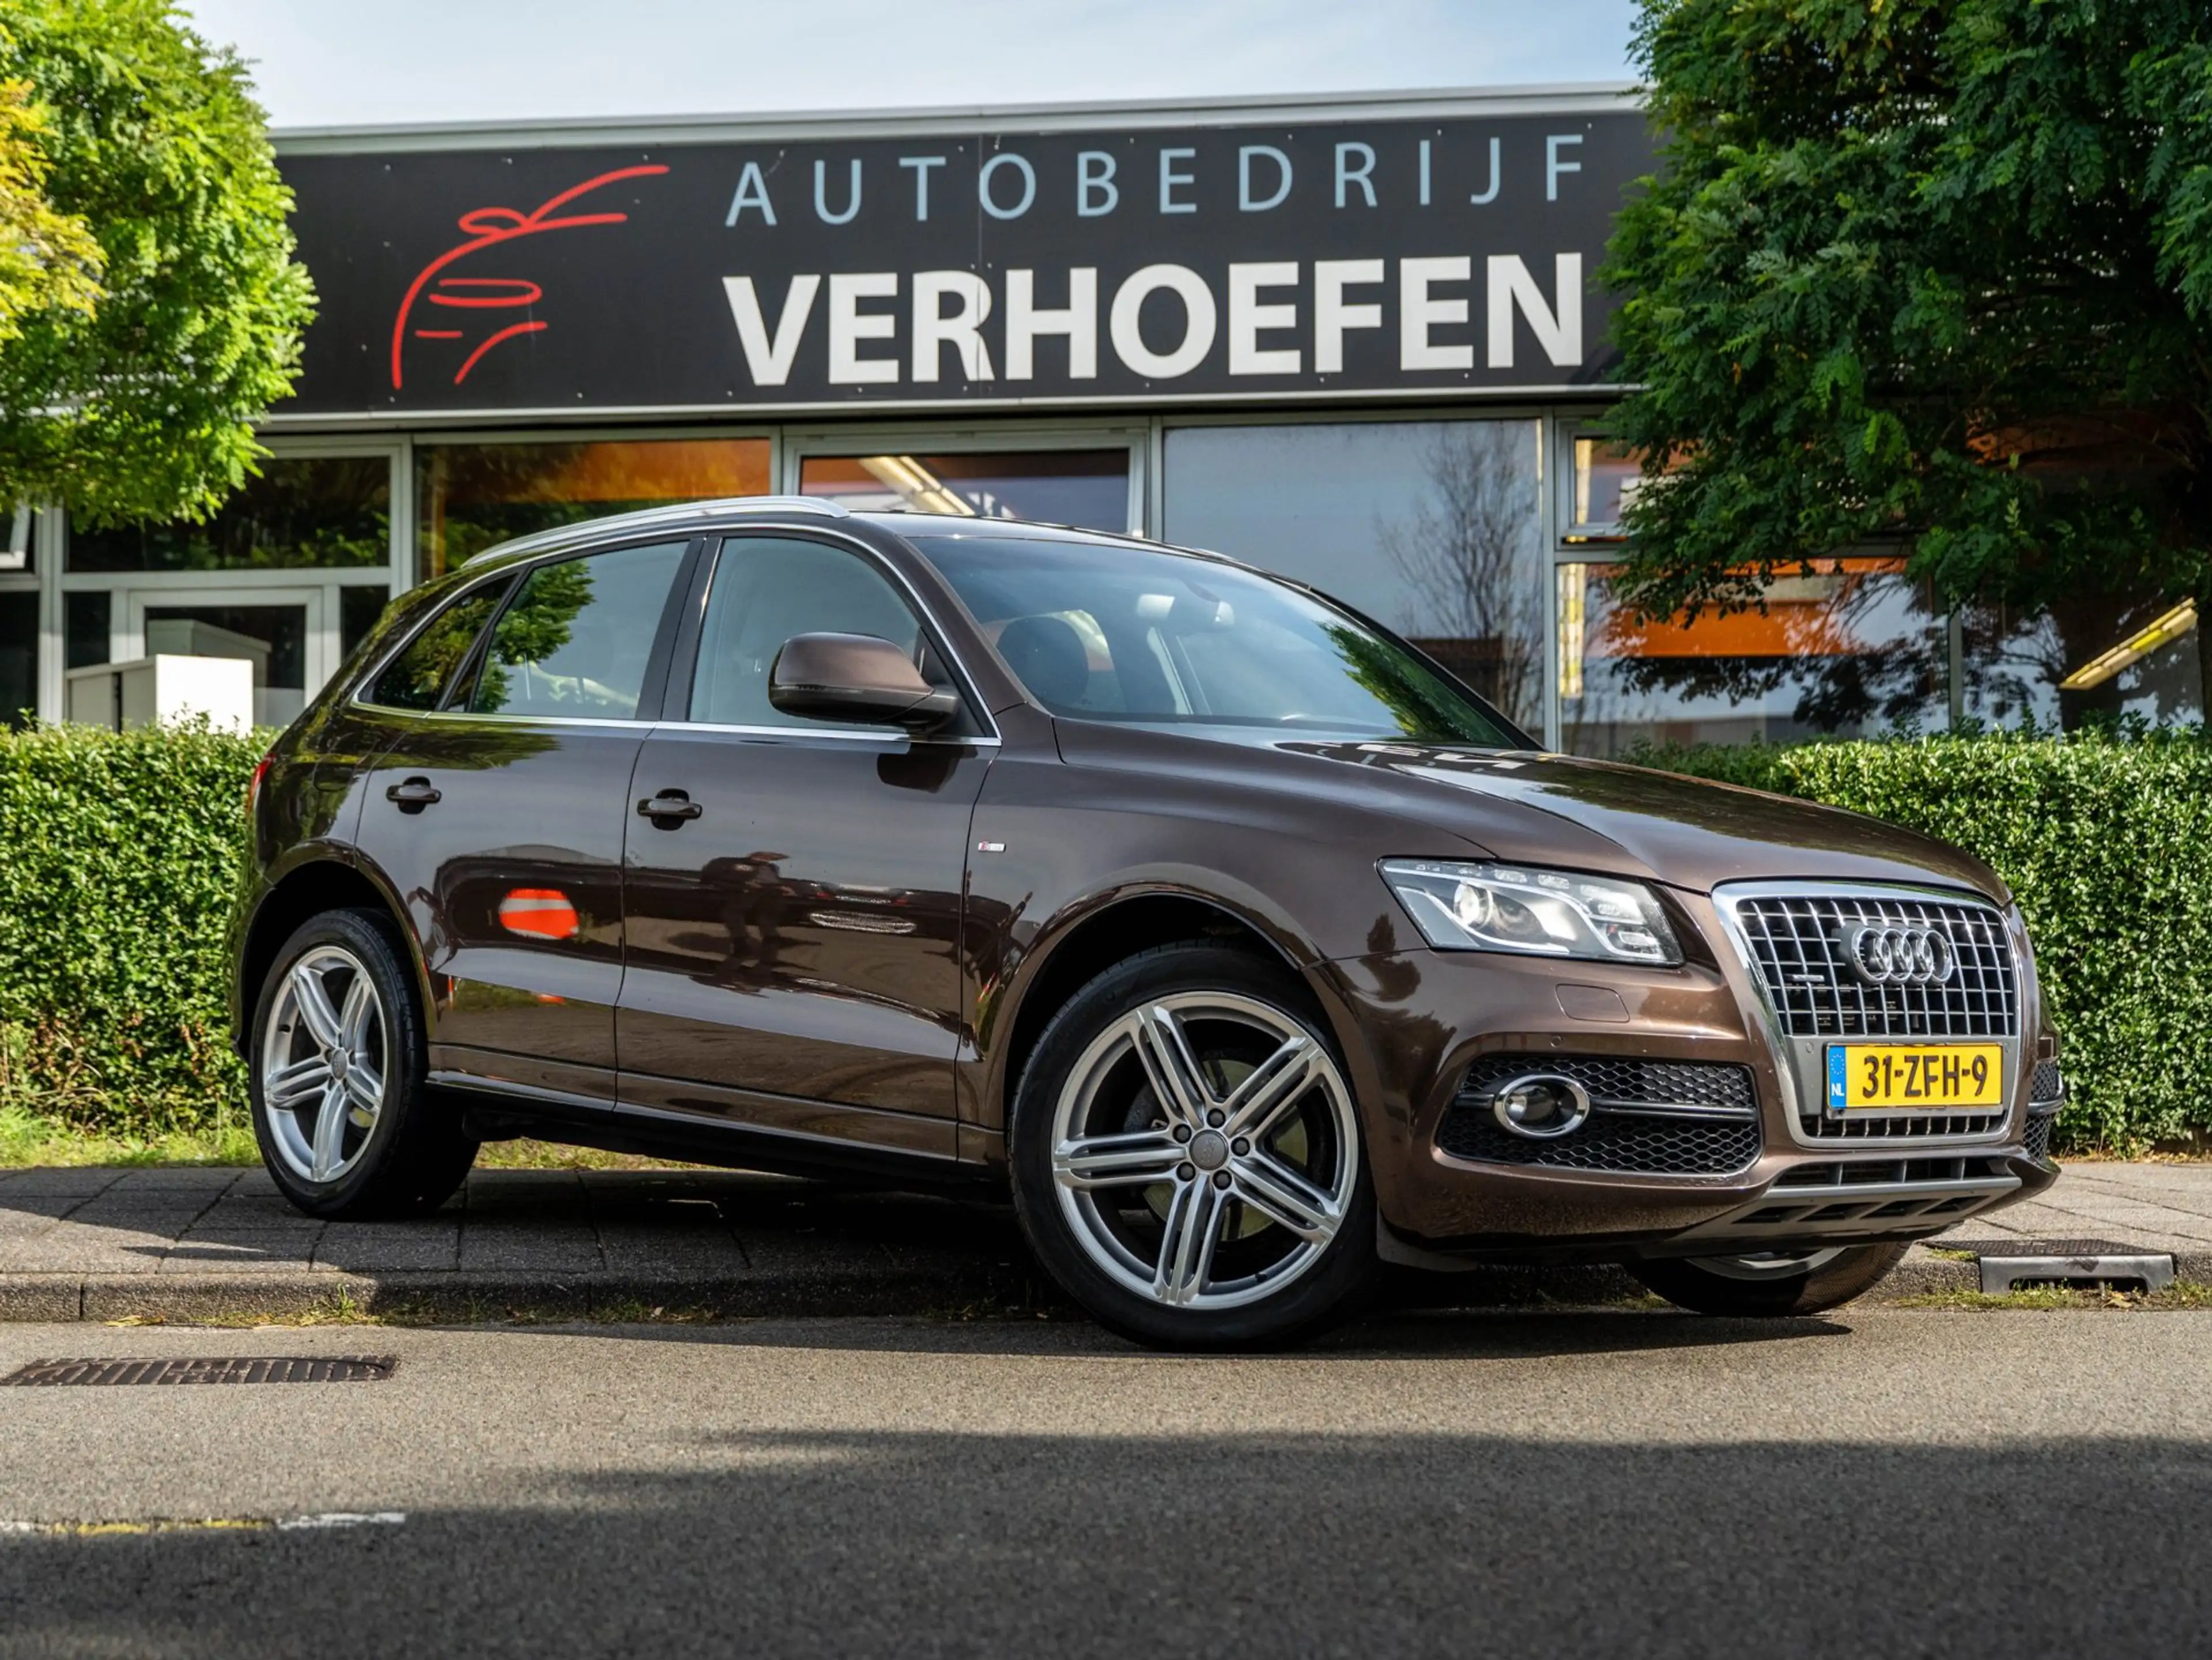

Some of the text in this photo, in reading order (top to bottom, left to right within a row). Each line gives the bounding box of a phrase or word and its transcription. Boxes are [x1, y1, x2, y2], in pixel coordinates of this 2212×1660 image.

[725, 135, 1583, 227] AUTOBEDRIJF
[722, 252, 1583, 387] VERHOEFEN
[1831, 1083, 1845, 1096] NL
[1863, 1054, 1988, 1099] 31-ZFH-9
